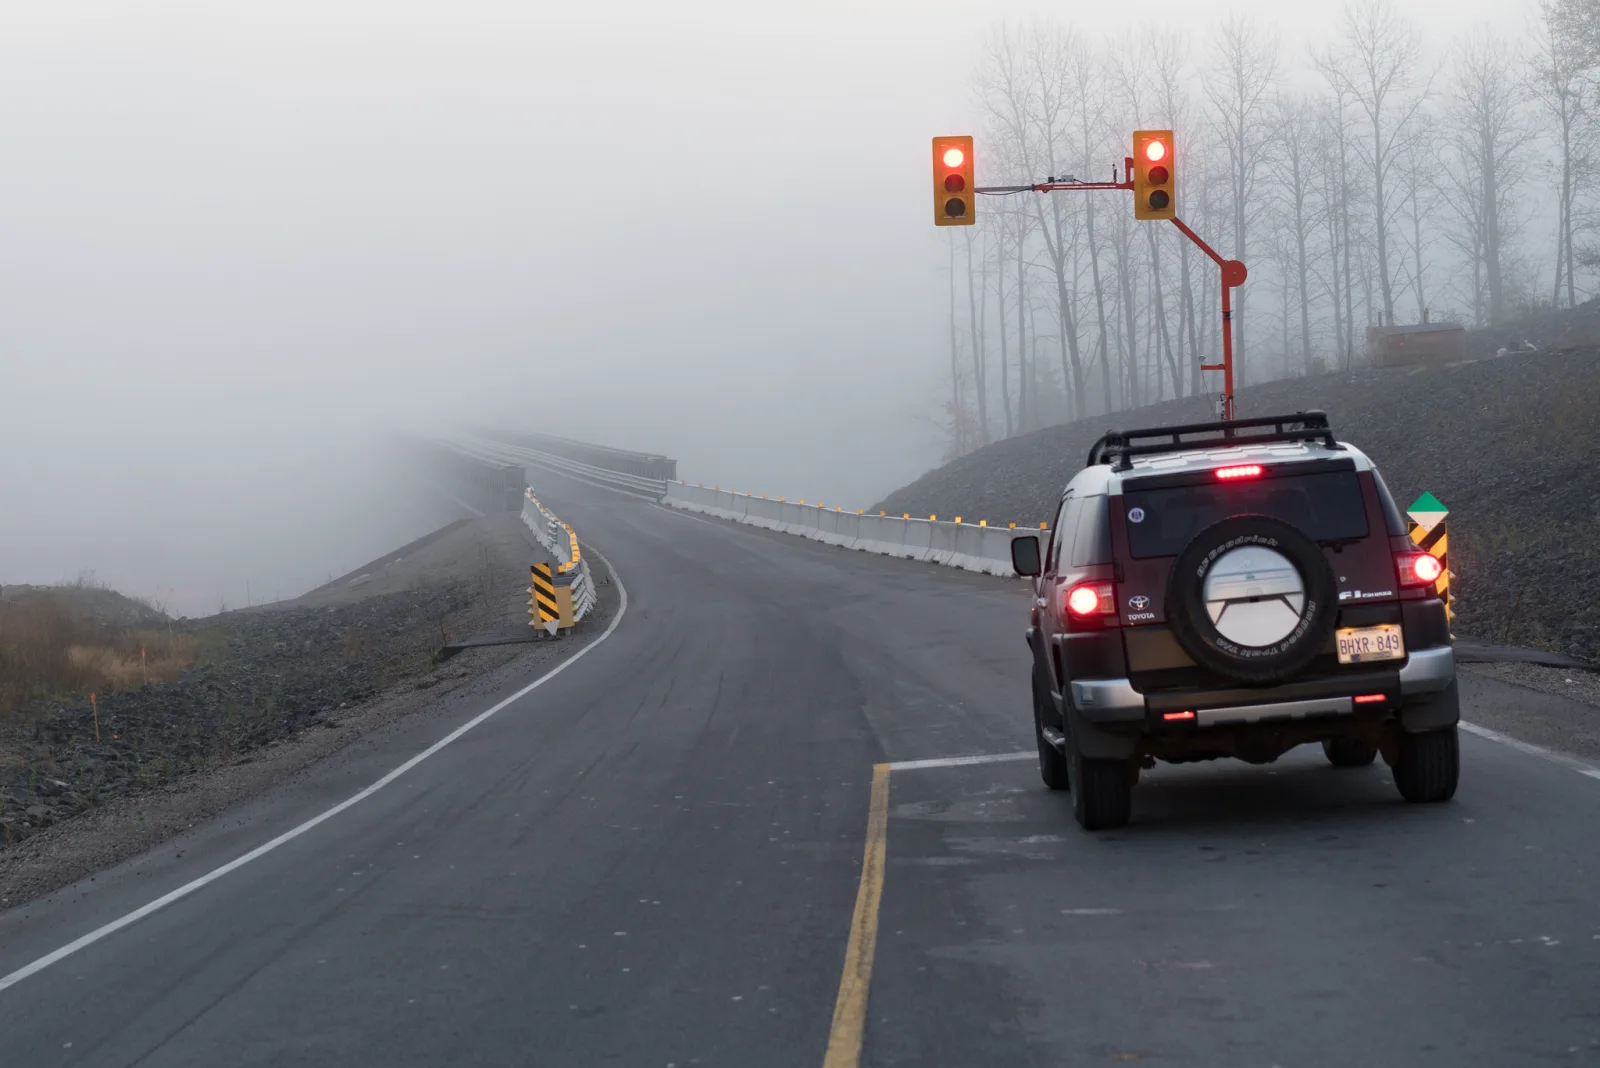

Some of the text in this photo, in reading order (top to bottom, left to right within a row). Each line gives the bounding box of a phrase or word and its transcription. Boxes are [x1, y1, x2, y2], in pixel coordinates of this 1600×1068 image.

[1128, 612, 1155, 620] TOYOTA
[1340, 634, 1399, 655] BHXR 849
